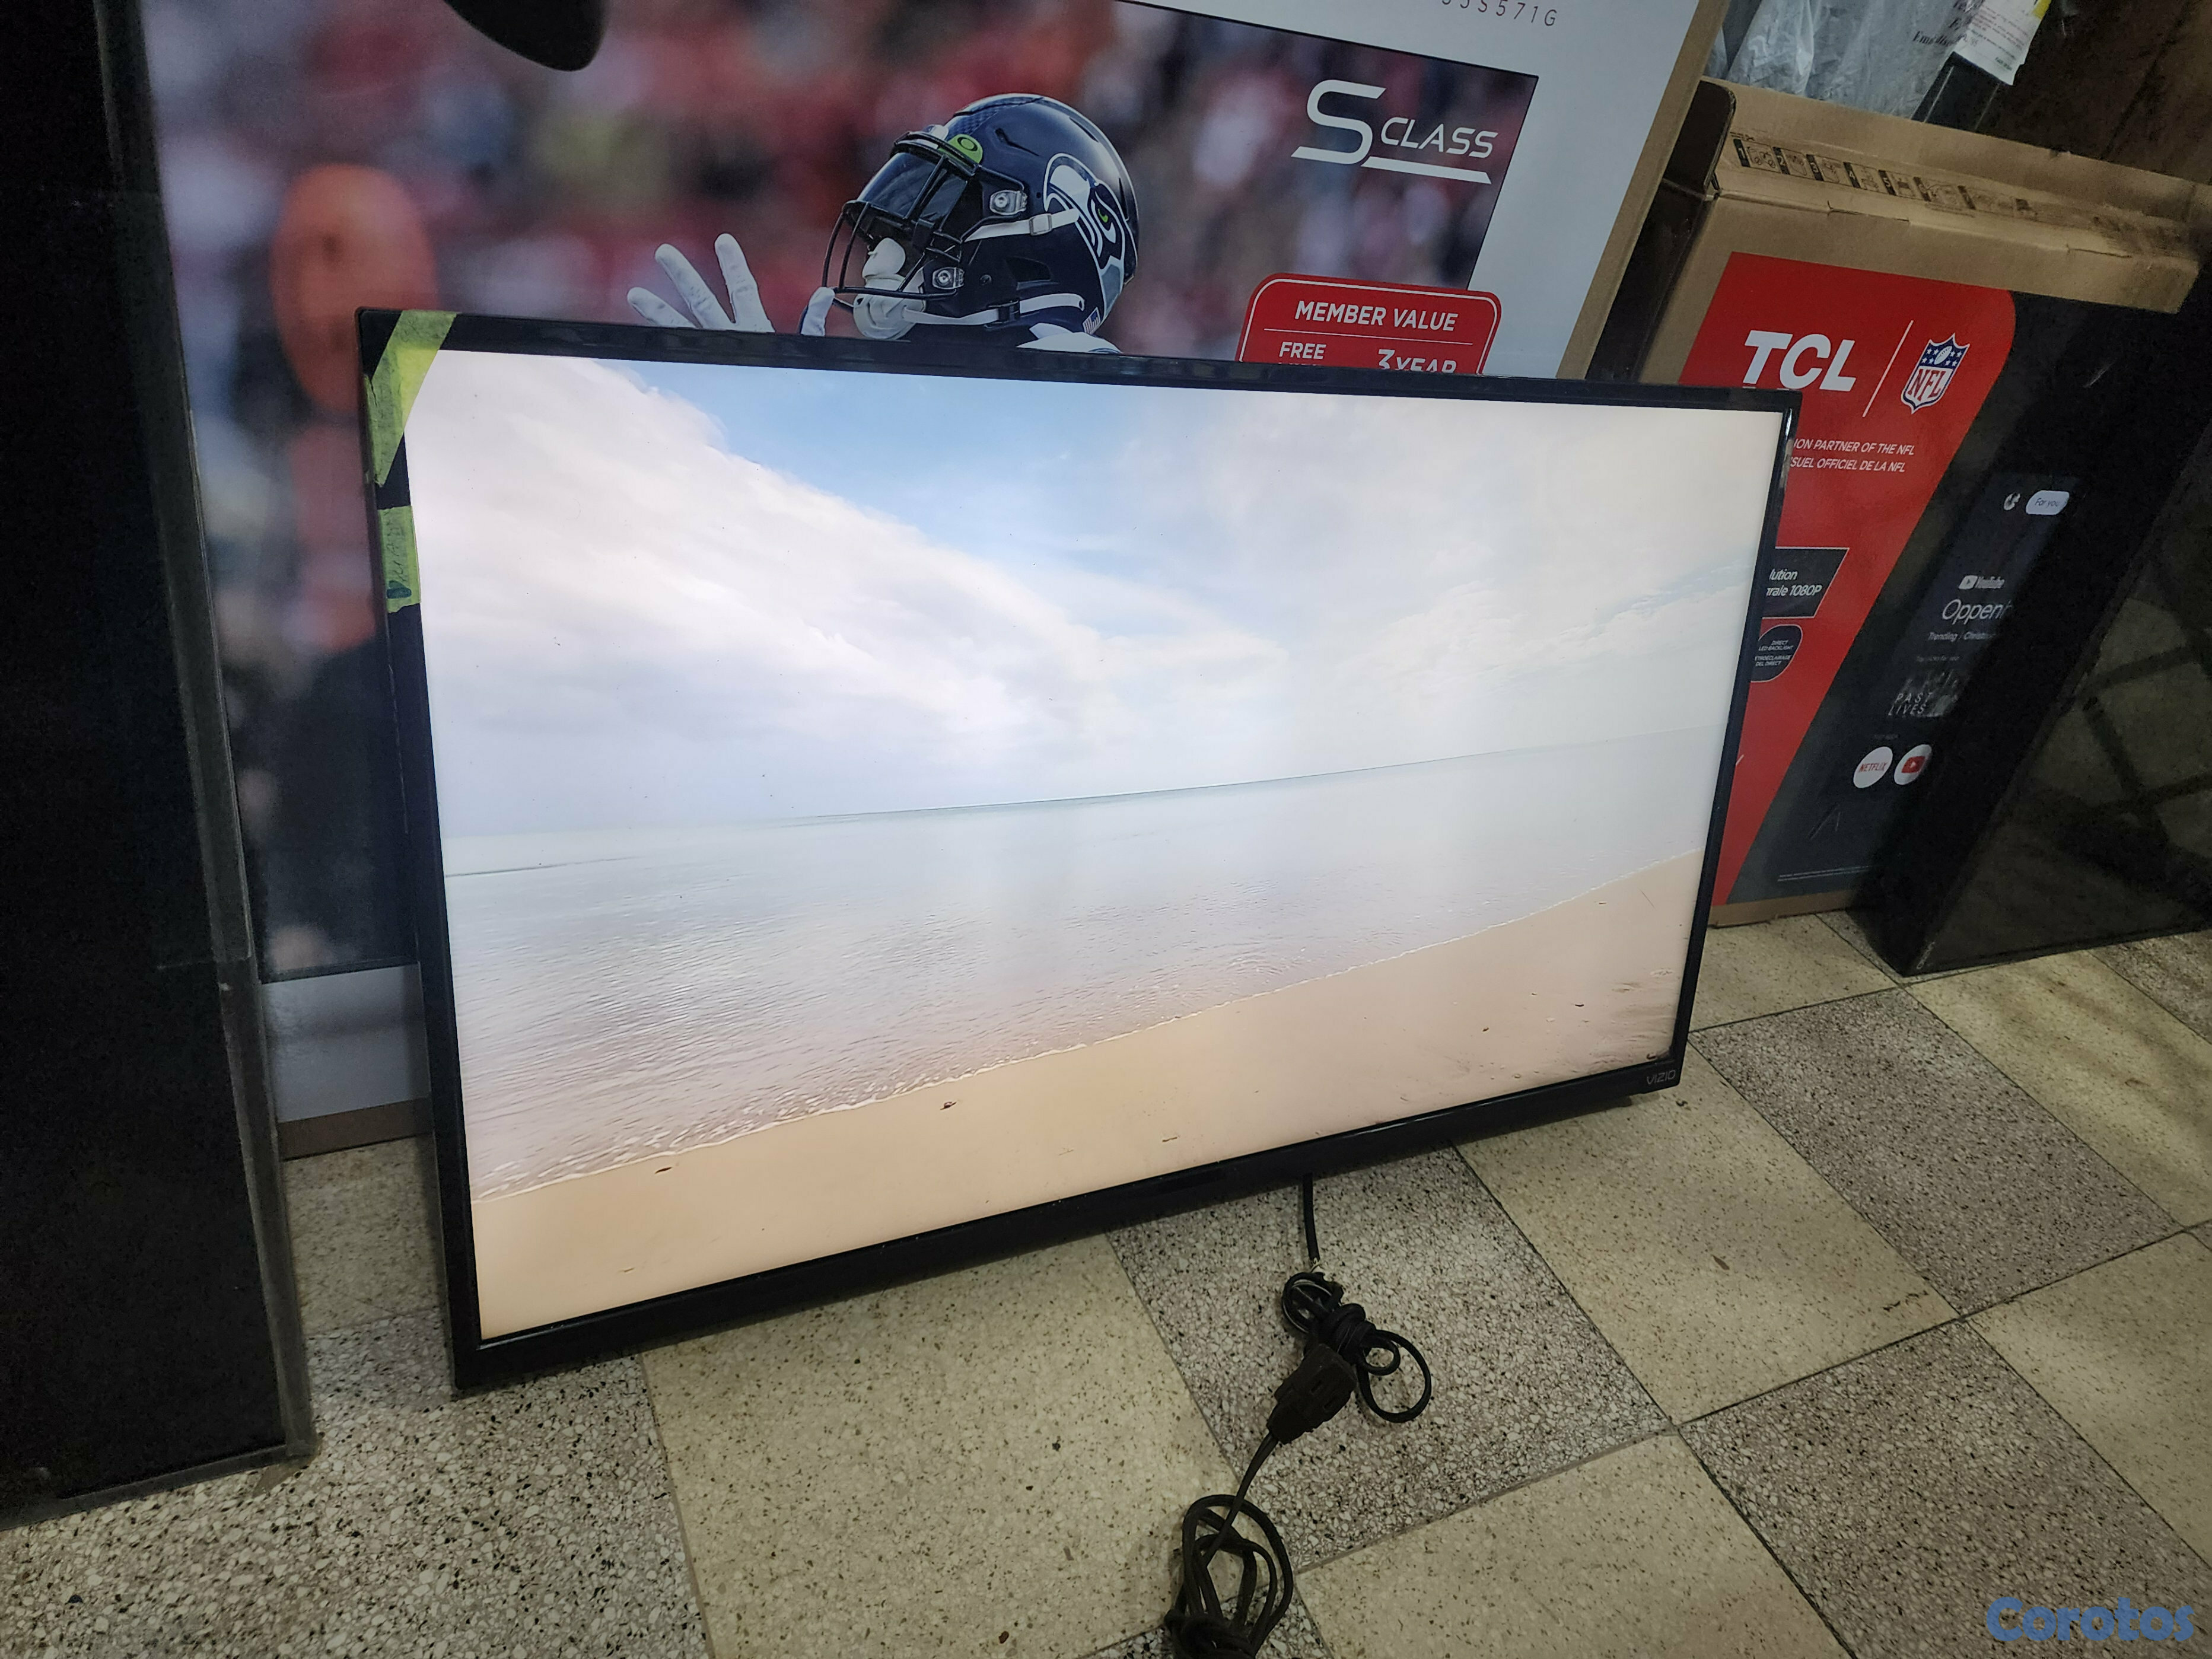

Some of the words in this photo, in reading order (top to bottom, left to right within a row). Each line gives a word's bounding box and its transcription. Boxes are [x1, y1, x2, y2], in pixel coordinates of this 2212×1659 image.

[1442, 0, 1557, 27] S571G
[1291, 79, 1386, 165] S
[1380, 116, 1498, 159] CLASS
[1294, 300, 1387, 326] MEMBER
[1393, 308, 1459, 332] VALUE
[1278, 341, 1327, 359] FREE
[1742, 330, 1857, 392] TCL
[1908, 368, 1945, 402] NFL
[1813, 440, 1861, 453] PARTNER
[1861, 442, 1877, 453] OF
[1877, 443, 1898, 454] THE
[1896, 444, 1915, 456] NFL
[1817, 457, 1857, 470] OFFICIEL
[1860, 460, 1873, 471] DE
[1873, 461, 1887, 472] LA
[1887, 461, 1906, 473] NFL
[1789, 585, 1822, 596] 1080P
[1860, 762, 1888, 772] NETFLIX
[1647, 1070, 1676, 1085] VIZIO
